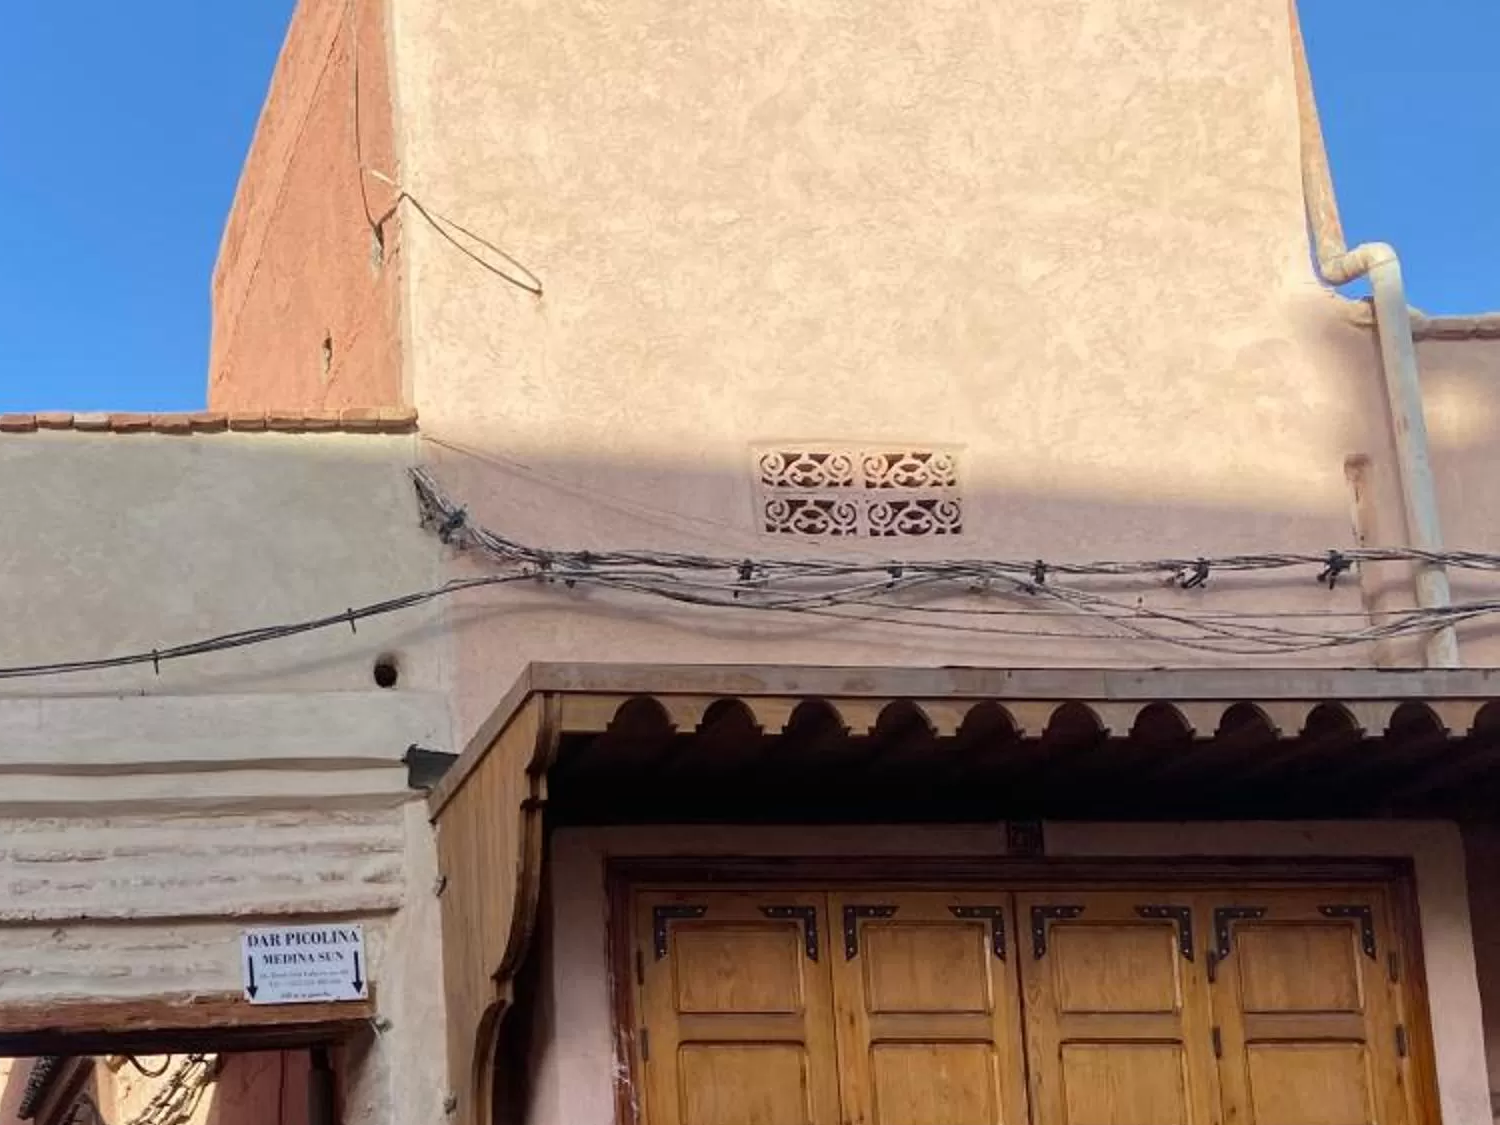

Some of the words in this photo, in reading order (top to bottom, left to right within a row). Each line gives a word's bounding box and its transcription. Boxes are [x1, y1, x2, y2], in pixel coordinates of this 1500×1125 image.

[247, 934, 281, 947] DAR
[284, 930, 360, 947] PICOLINA
[263, 953, 315, 965] MEDINA
[318, 951, 344, 962] SUN
